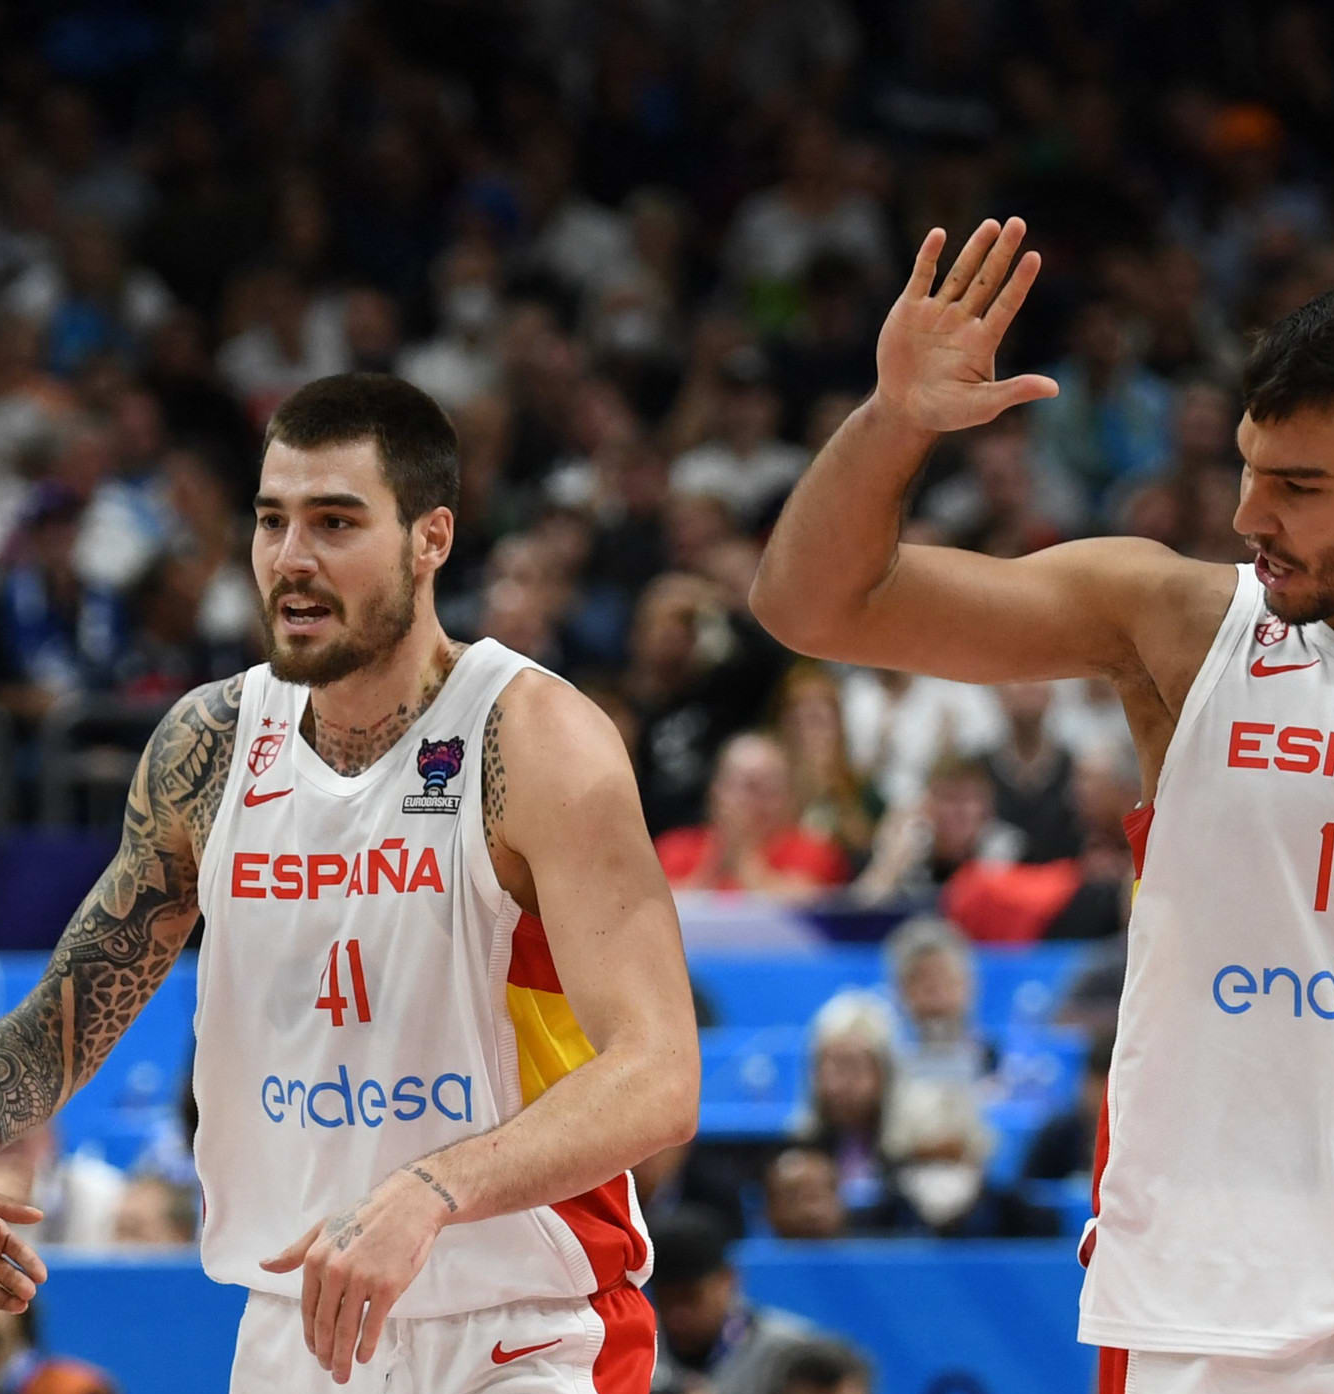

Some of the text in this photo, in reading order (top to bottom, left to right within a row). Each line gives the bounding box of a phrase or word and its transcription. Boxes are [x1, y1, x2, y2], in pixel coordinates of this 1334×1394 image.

[231, 838, 445, 900] ESPAÑA
[314, 939, 372, 1027] 41
[261, 1064, 473, 1129] endesa
